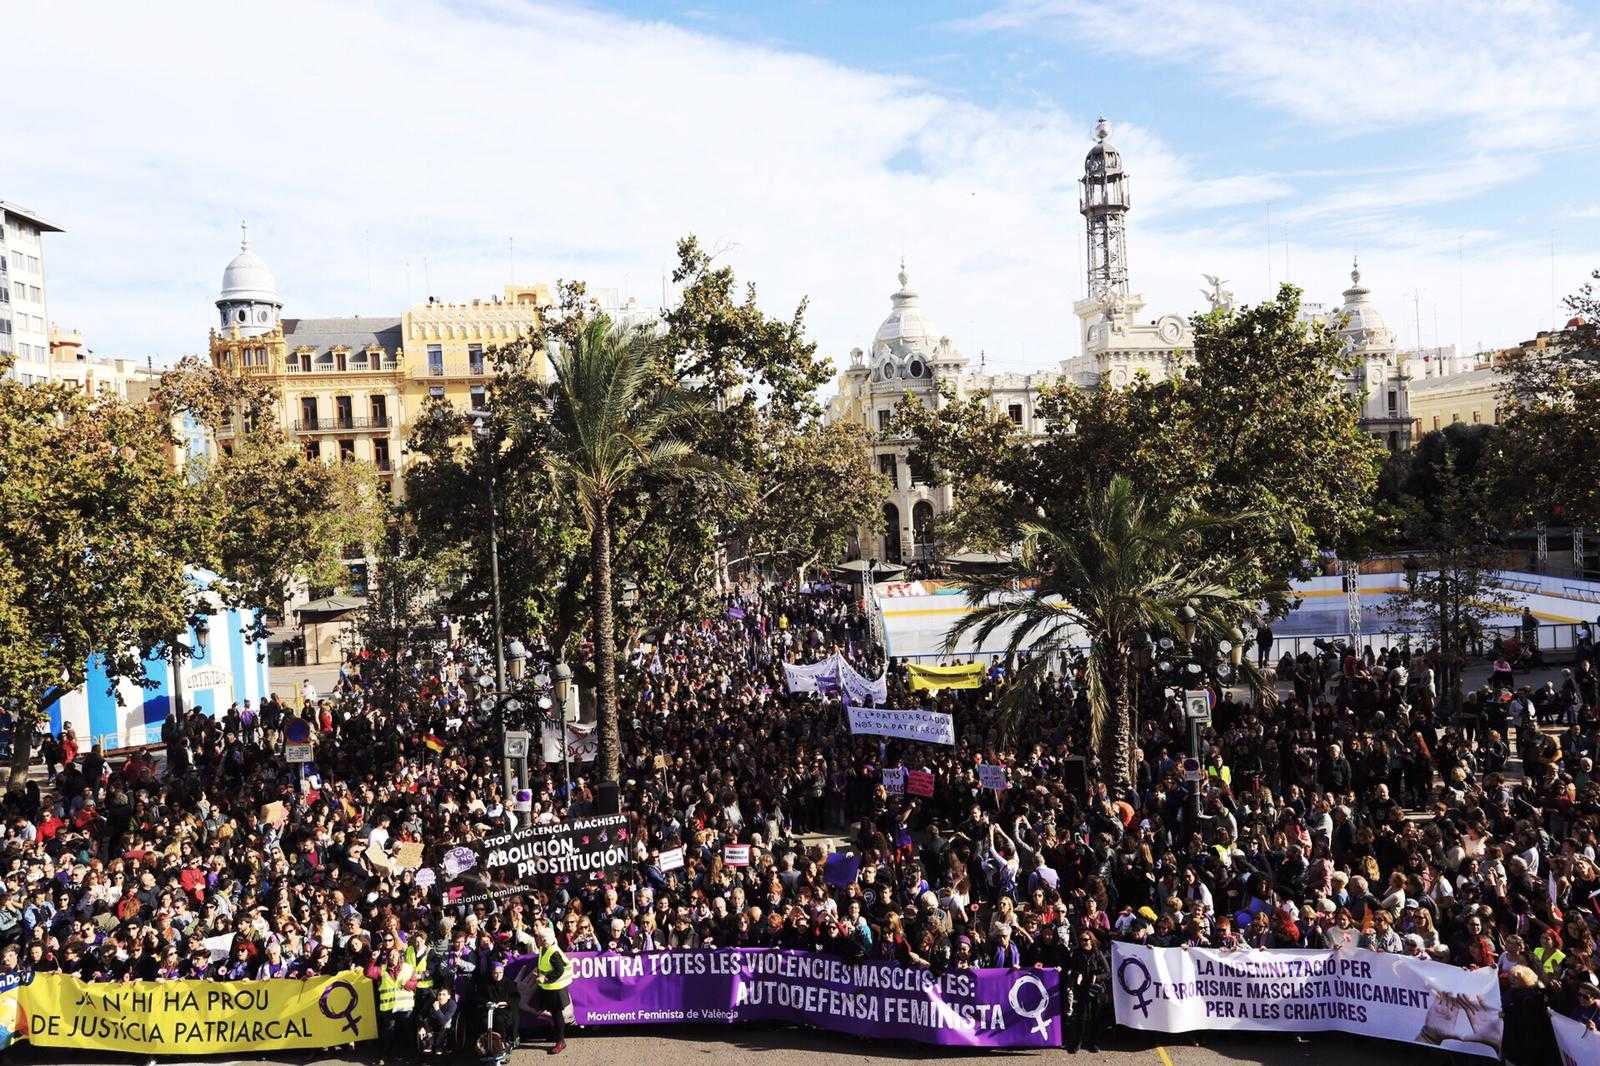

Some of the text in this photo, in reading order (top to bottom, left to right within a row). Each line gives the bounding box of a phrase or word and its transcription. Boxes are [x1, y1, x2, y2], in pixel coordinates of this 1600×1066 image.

[484, 815, 628, 848] STOP VIOLENCIA MACHISTA
[487, 835, 574, 868] ABOLICIÓN
[517, 844, 629, 879] PROSTITUCIÓN
[570, 955, 644, 979] CONTRA
[648, 953, 706, 976] TOTES
[710, 953, 742, 976] LES
[1196, 953, 1372, 979] LA INDEMNITZACIÓ PER
[76, 989, 269, 1013] JA N'HI HA PROU
[1153, 980, 1243, 1000] TERRORISME
[1246, 980, 1332, 1000] MASCLISTA
[587, 1010, 635, 1022] Moviment
[638, 1009, 685, 1020] Feminista
[687, 1009, 699, 1019] de
[735, 981, 1006, 1031] AUTODEFENSA FEMINISTA
[1205, 1000, 1368, 1023] PER A LES CRIATURES
[31, 1014, 313, 1043] DE JUSTÍCIA PATRIARCAL
